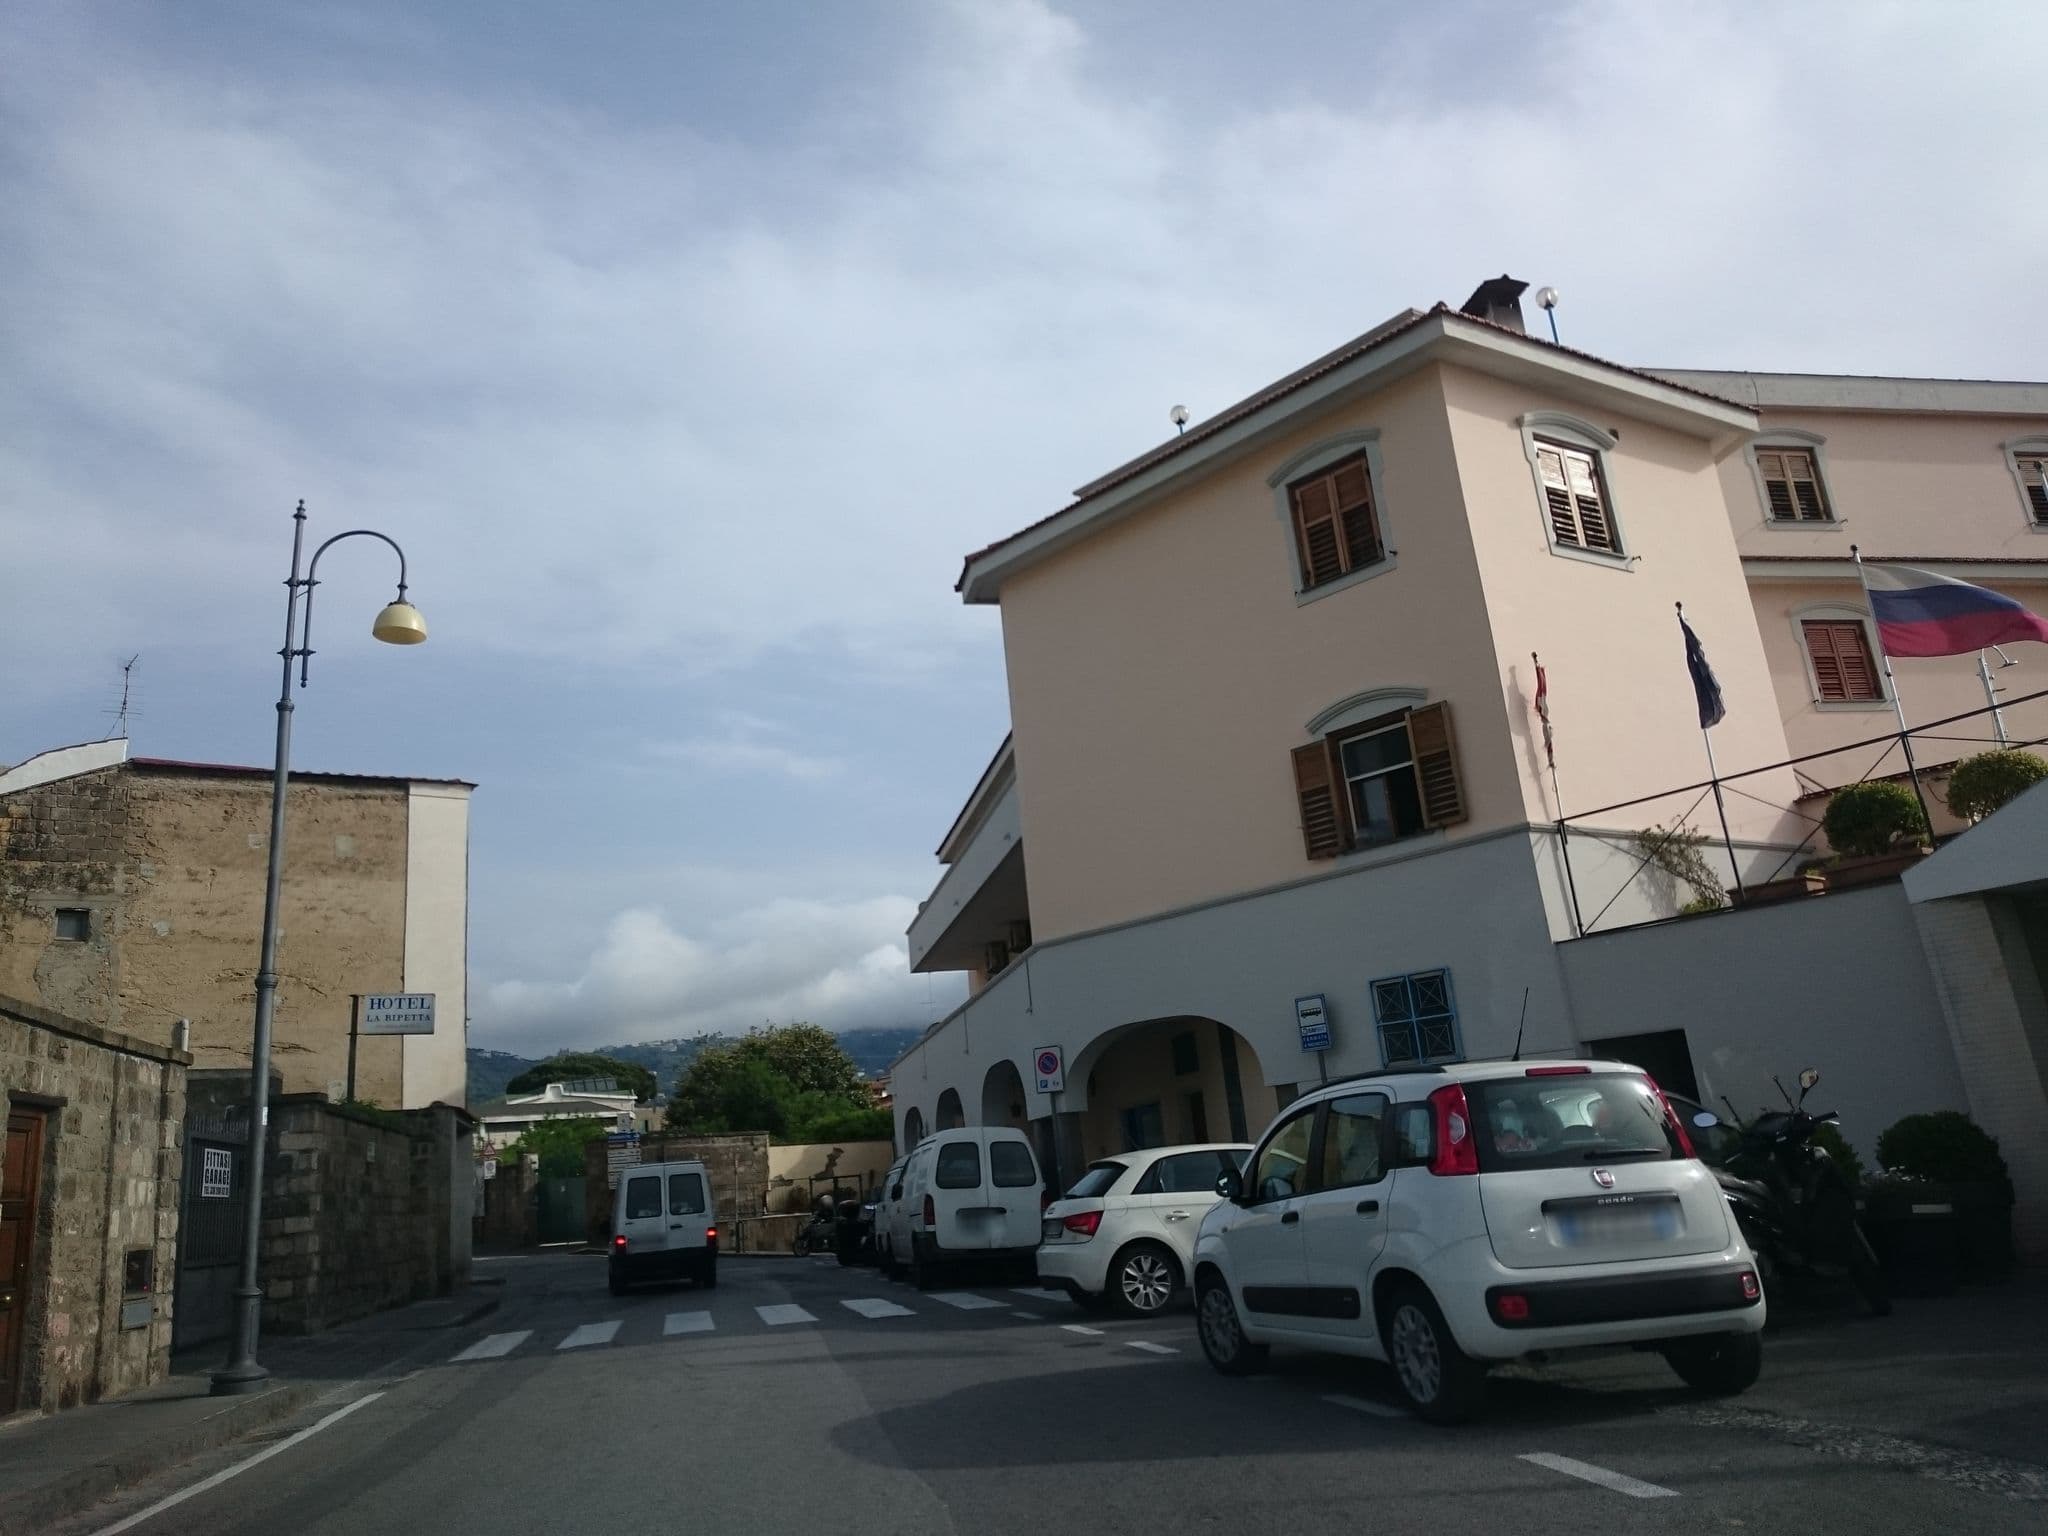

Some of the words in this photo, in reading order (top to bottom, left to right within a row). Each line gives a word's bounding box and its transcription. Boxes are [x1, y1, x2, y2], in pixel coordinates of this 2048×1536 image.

[369, 997, 430, 1010] HOTEL
[366, 1015, 380, 1023] LA
[385, 1013, 431, 1022] RIPETTA
[206, 1151, 230, 1168] FITTASI
[205, 1168, 230, 1185] GARAGE
